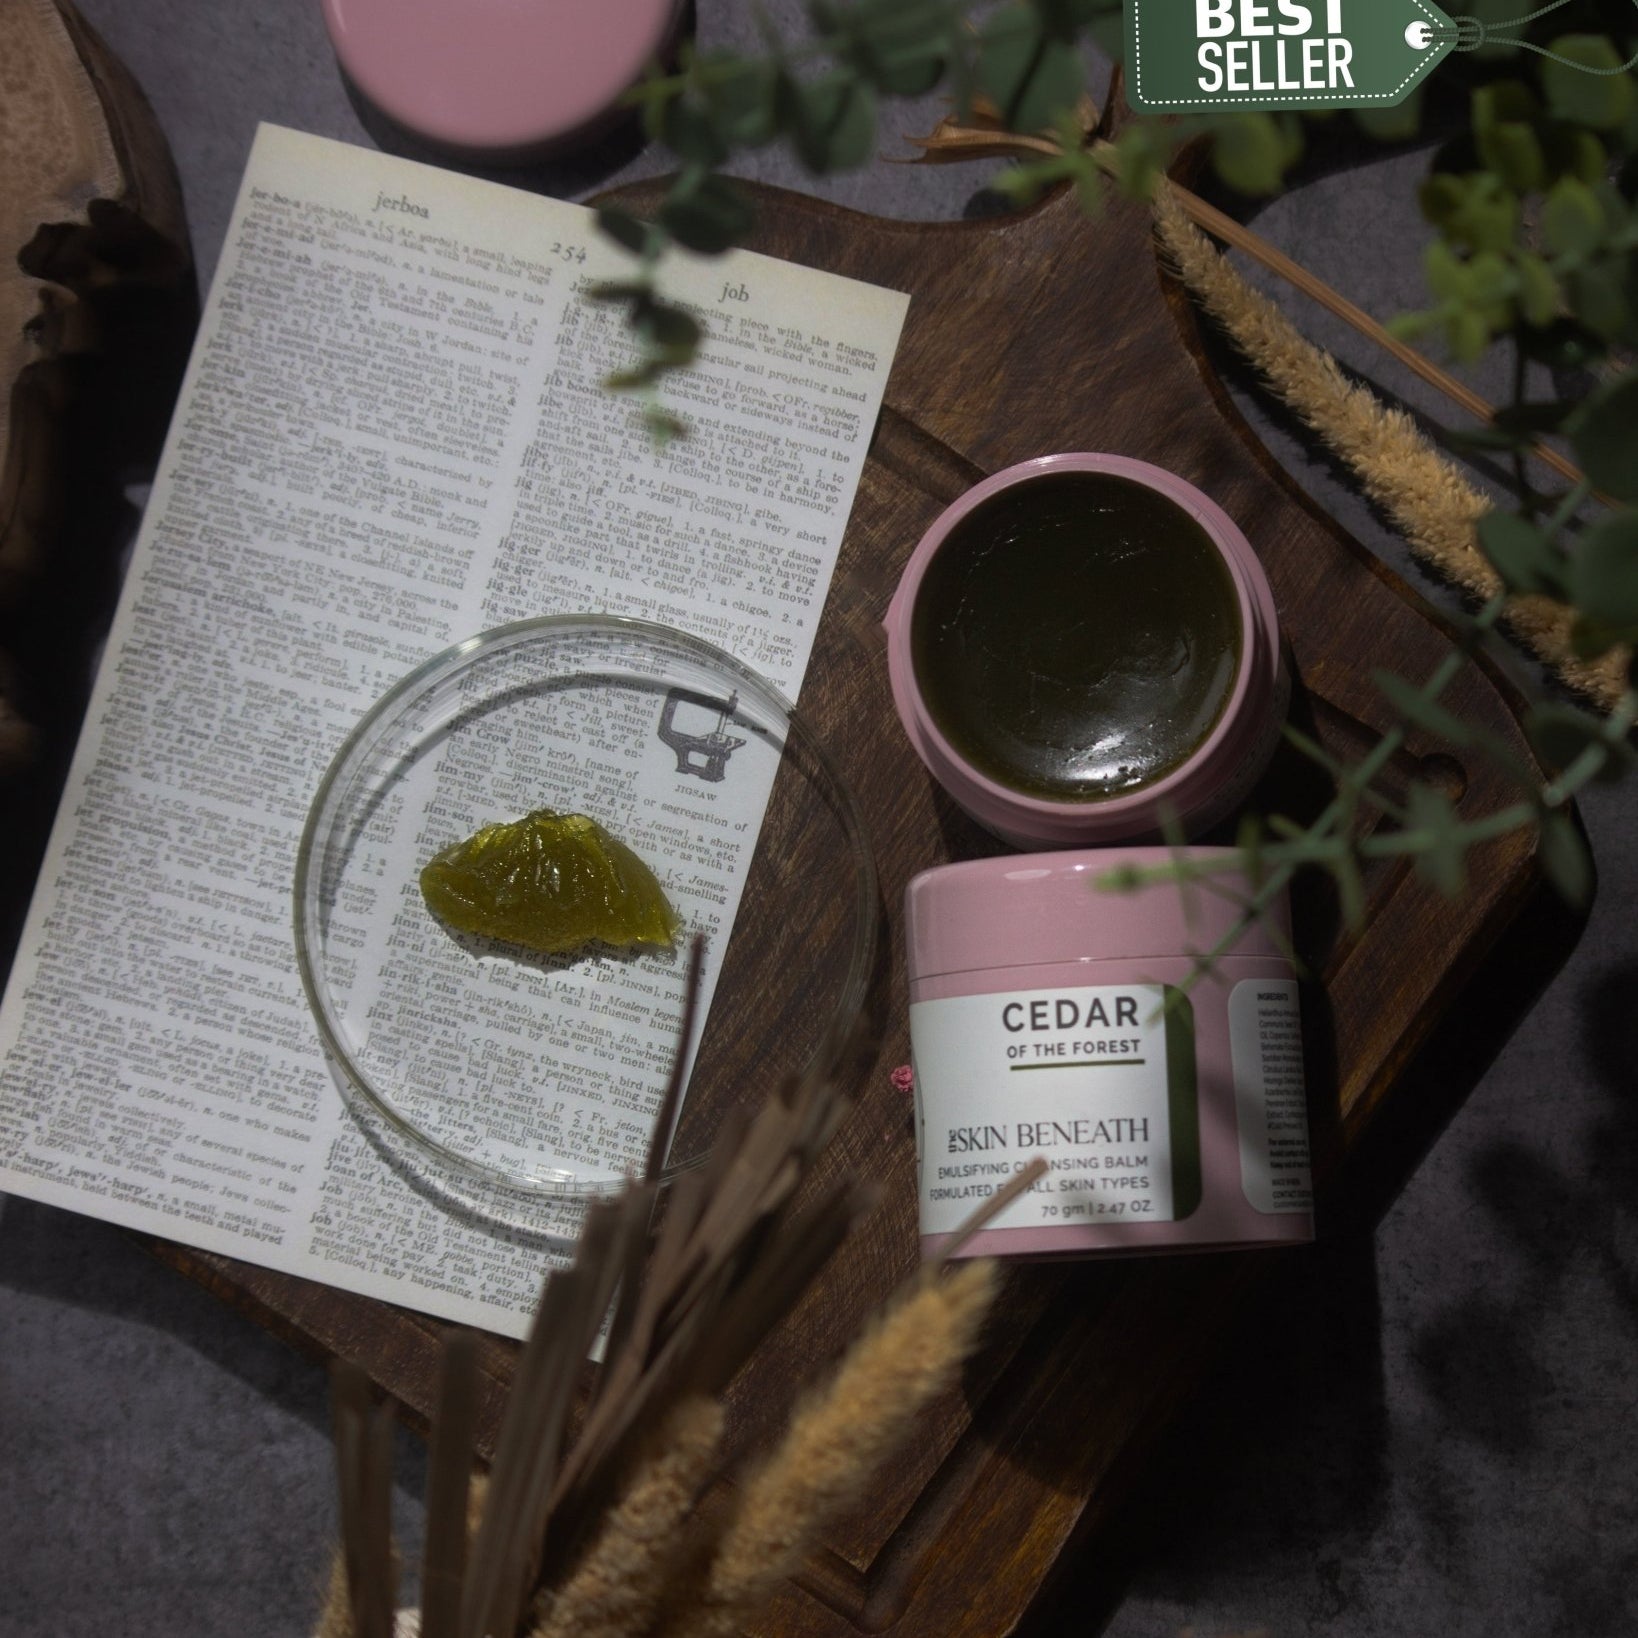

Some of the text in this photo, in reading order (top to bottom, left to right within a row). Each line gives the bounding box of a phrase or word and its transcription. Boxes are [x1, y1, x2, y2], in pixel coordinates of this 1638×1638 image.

[372, 191, 430, 219] jerboa
[550, 240, 588, 265] 254
[721, 281, 750, 303] job
[673, 783, 717, 803] JIGSAW
[1003, 996, 1140, 1033] CEDAR
[1007, 1039, 1141, 1060] OF THE FOREST
[957, 1125, 1007, 1152] SKIN
[1017, 1117, 1150, 1148] BENEATH
[938, 1156, 1148, 1180] EMULSIFYING CNSING BALM
[1060, 1178, 1095, 1192] SKIN
[1102, 1175, 1150, 1190] TYPES
[1041, 1205, 1057, 1218] 70
[1062, 1203, 1085, 1218] gm
